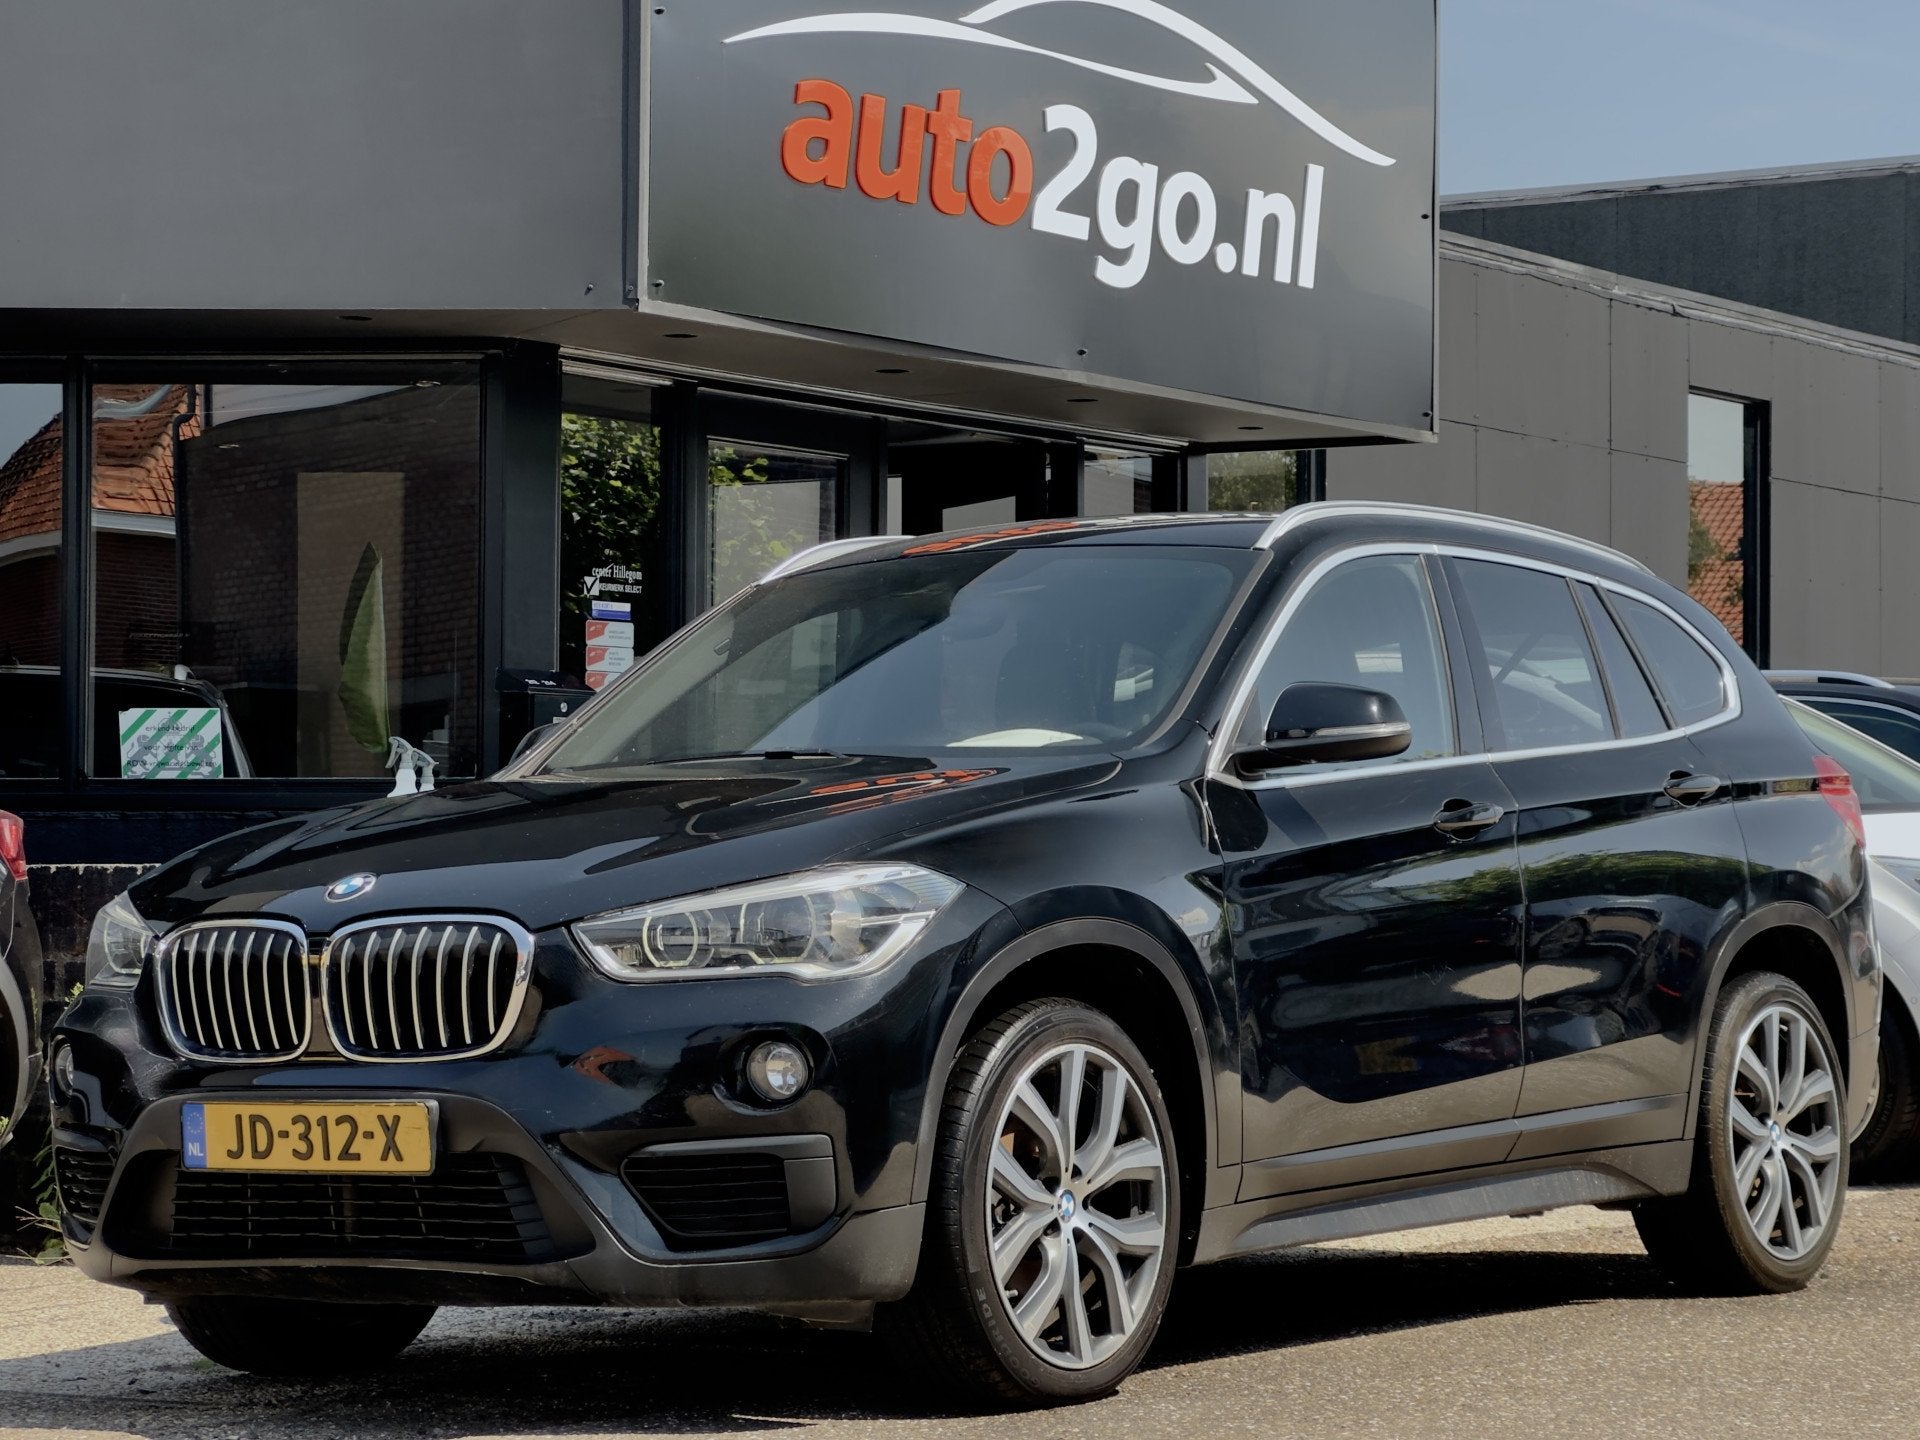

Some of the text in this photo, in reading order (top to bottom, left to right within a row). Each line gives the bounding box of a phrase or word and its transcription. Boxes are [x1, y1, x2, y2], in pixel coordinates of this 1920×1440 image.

[781, 78, 1325, 289] auto2go.nl
[613, 564, 643, 583] Hillegom
[624, 584, 642, 594] SELECT
[226, 1113, 404, 1162] JD-312-X
[188, 1142, 204, 1157] NL
